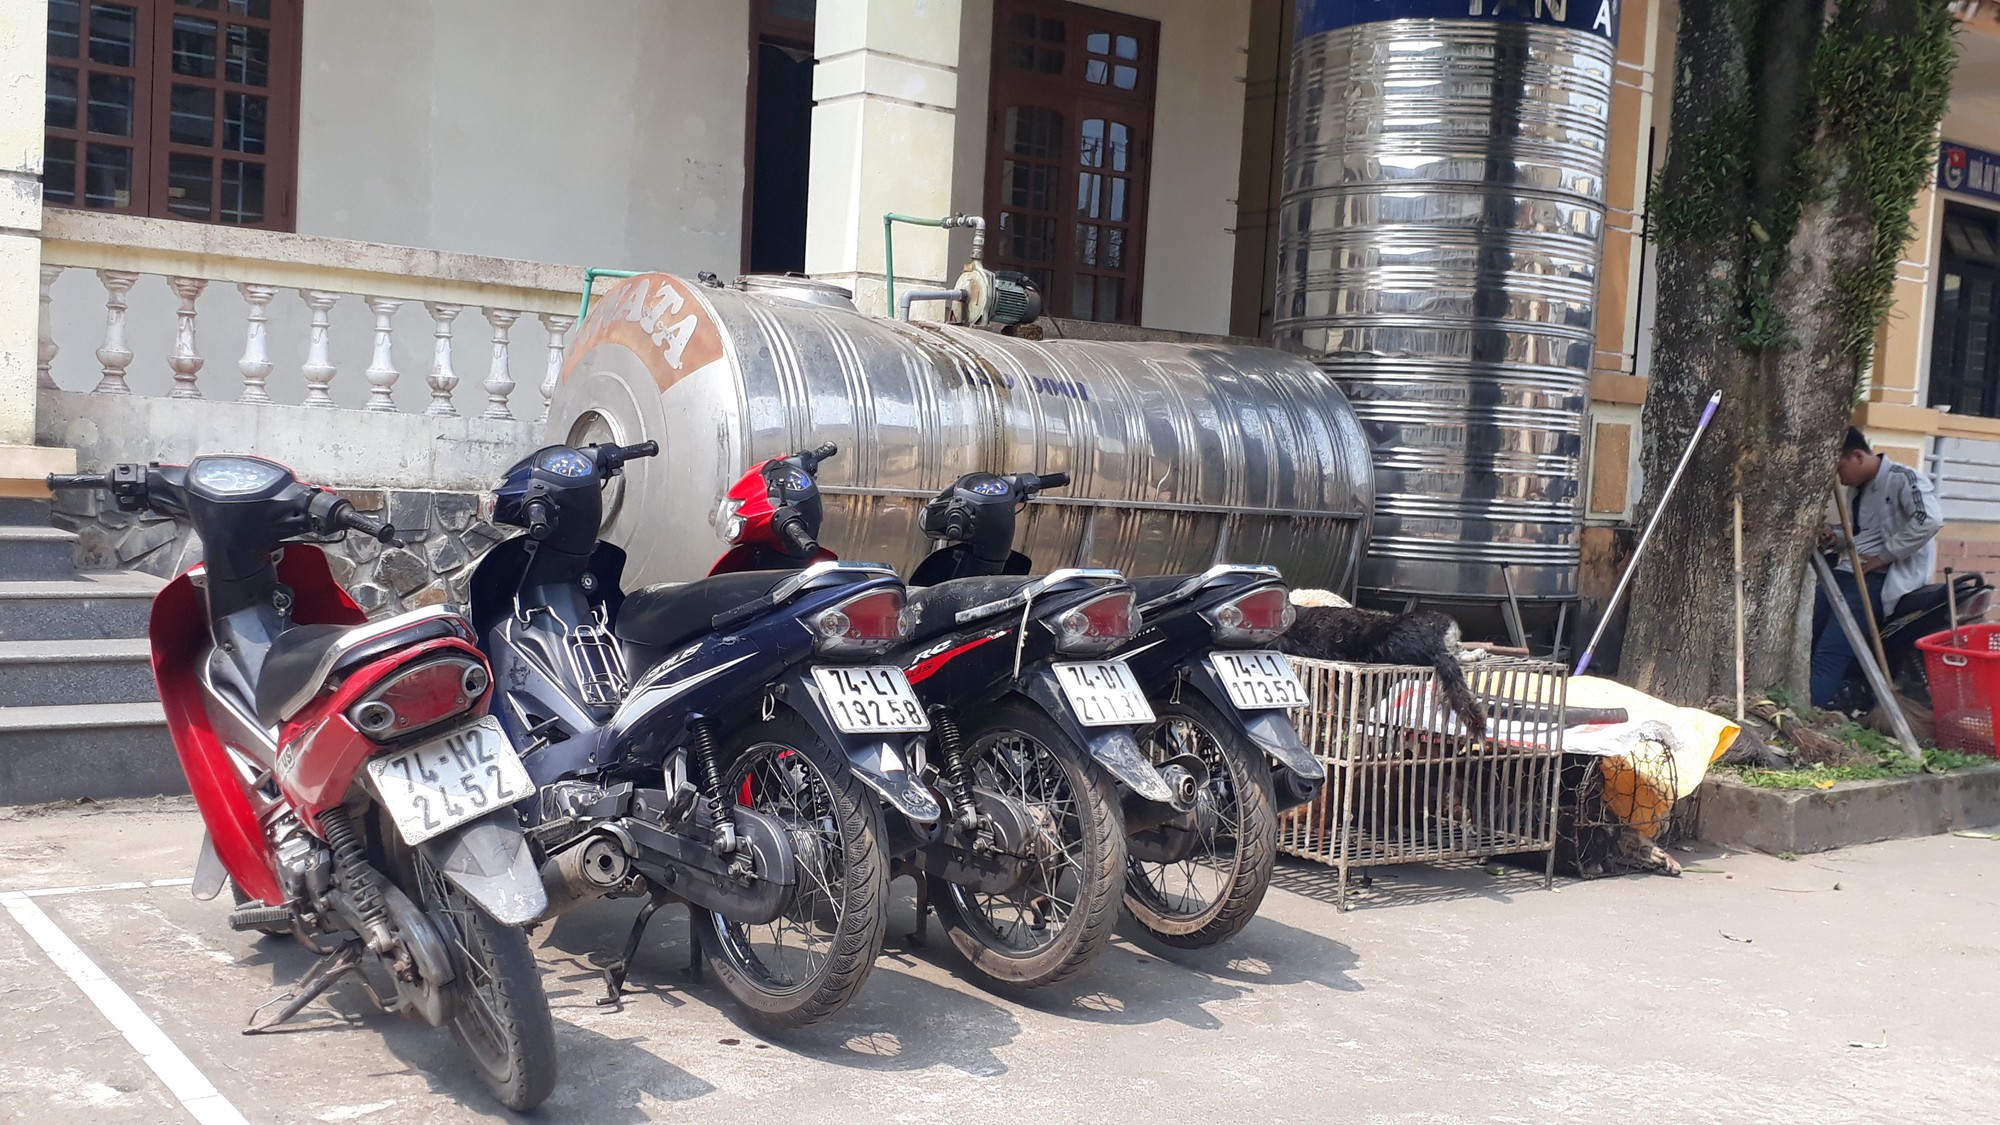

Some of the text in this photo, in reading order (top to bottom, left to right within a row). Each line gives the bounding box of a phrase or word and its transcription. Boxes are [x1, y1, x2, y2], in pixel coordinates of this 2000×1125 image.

[1067, 665, 1126, 690] 74-D1
[1224, 655, 1282, 677] 74-L1
[828, 670, 899, 696] 74-L1
[1233, 680, 1303, 705] 173.52
[837, 699, 922, 727] 192.58
[391, 730, 494, 793] 74-H2
[412, 765, 513, 831] 2452
